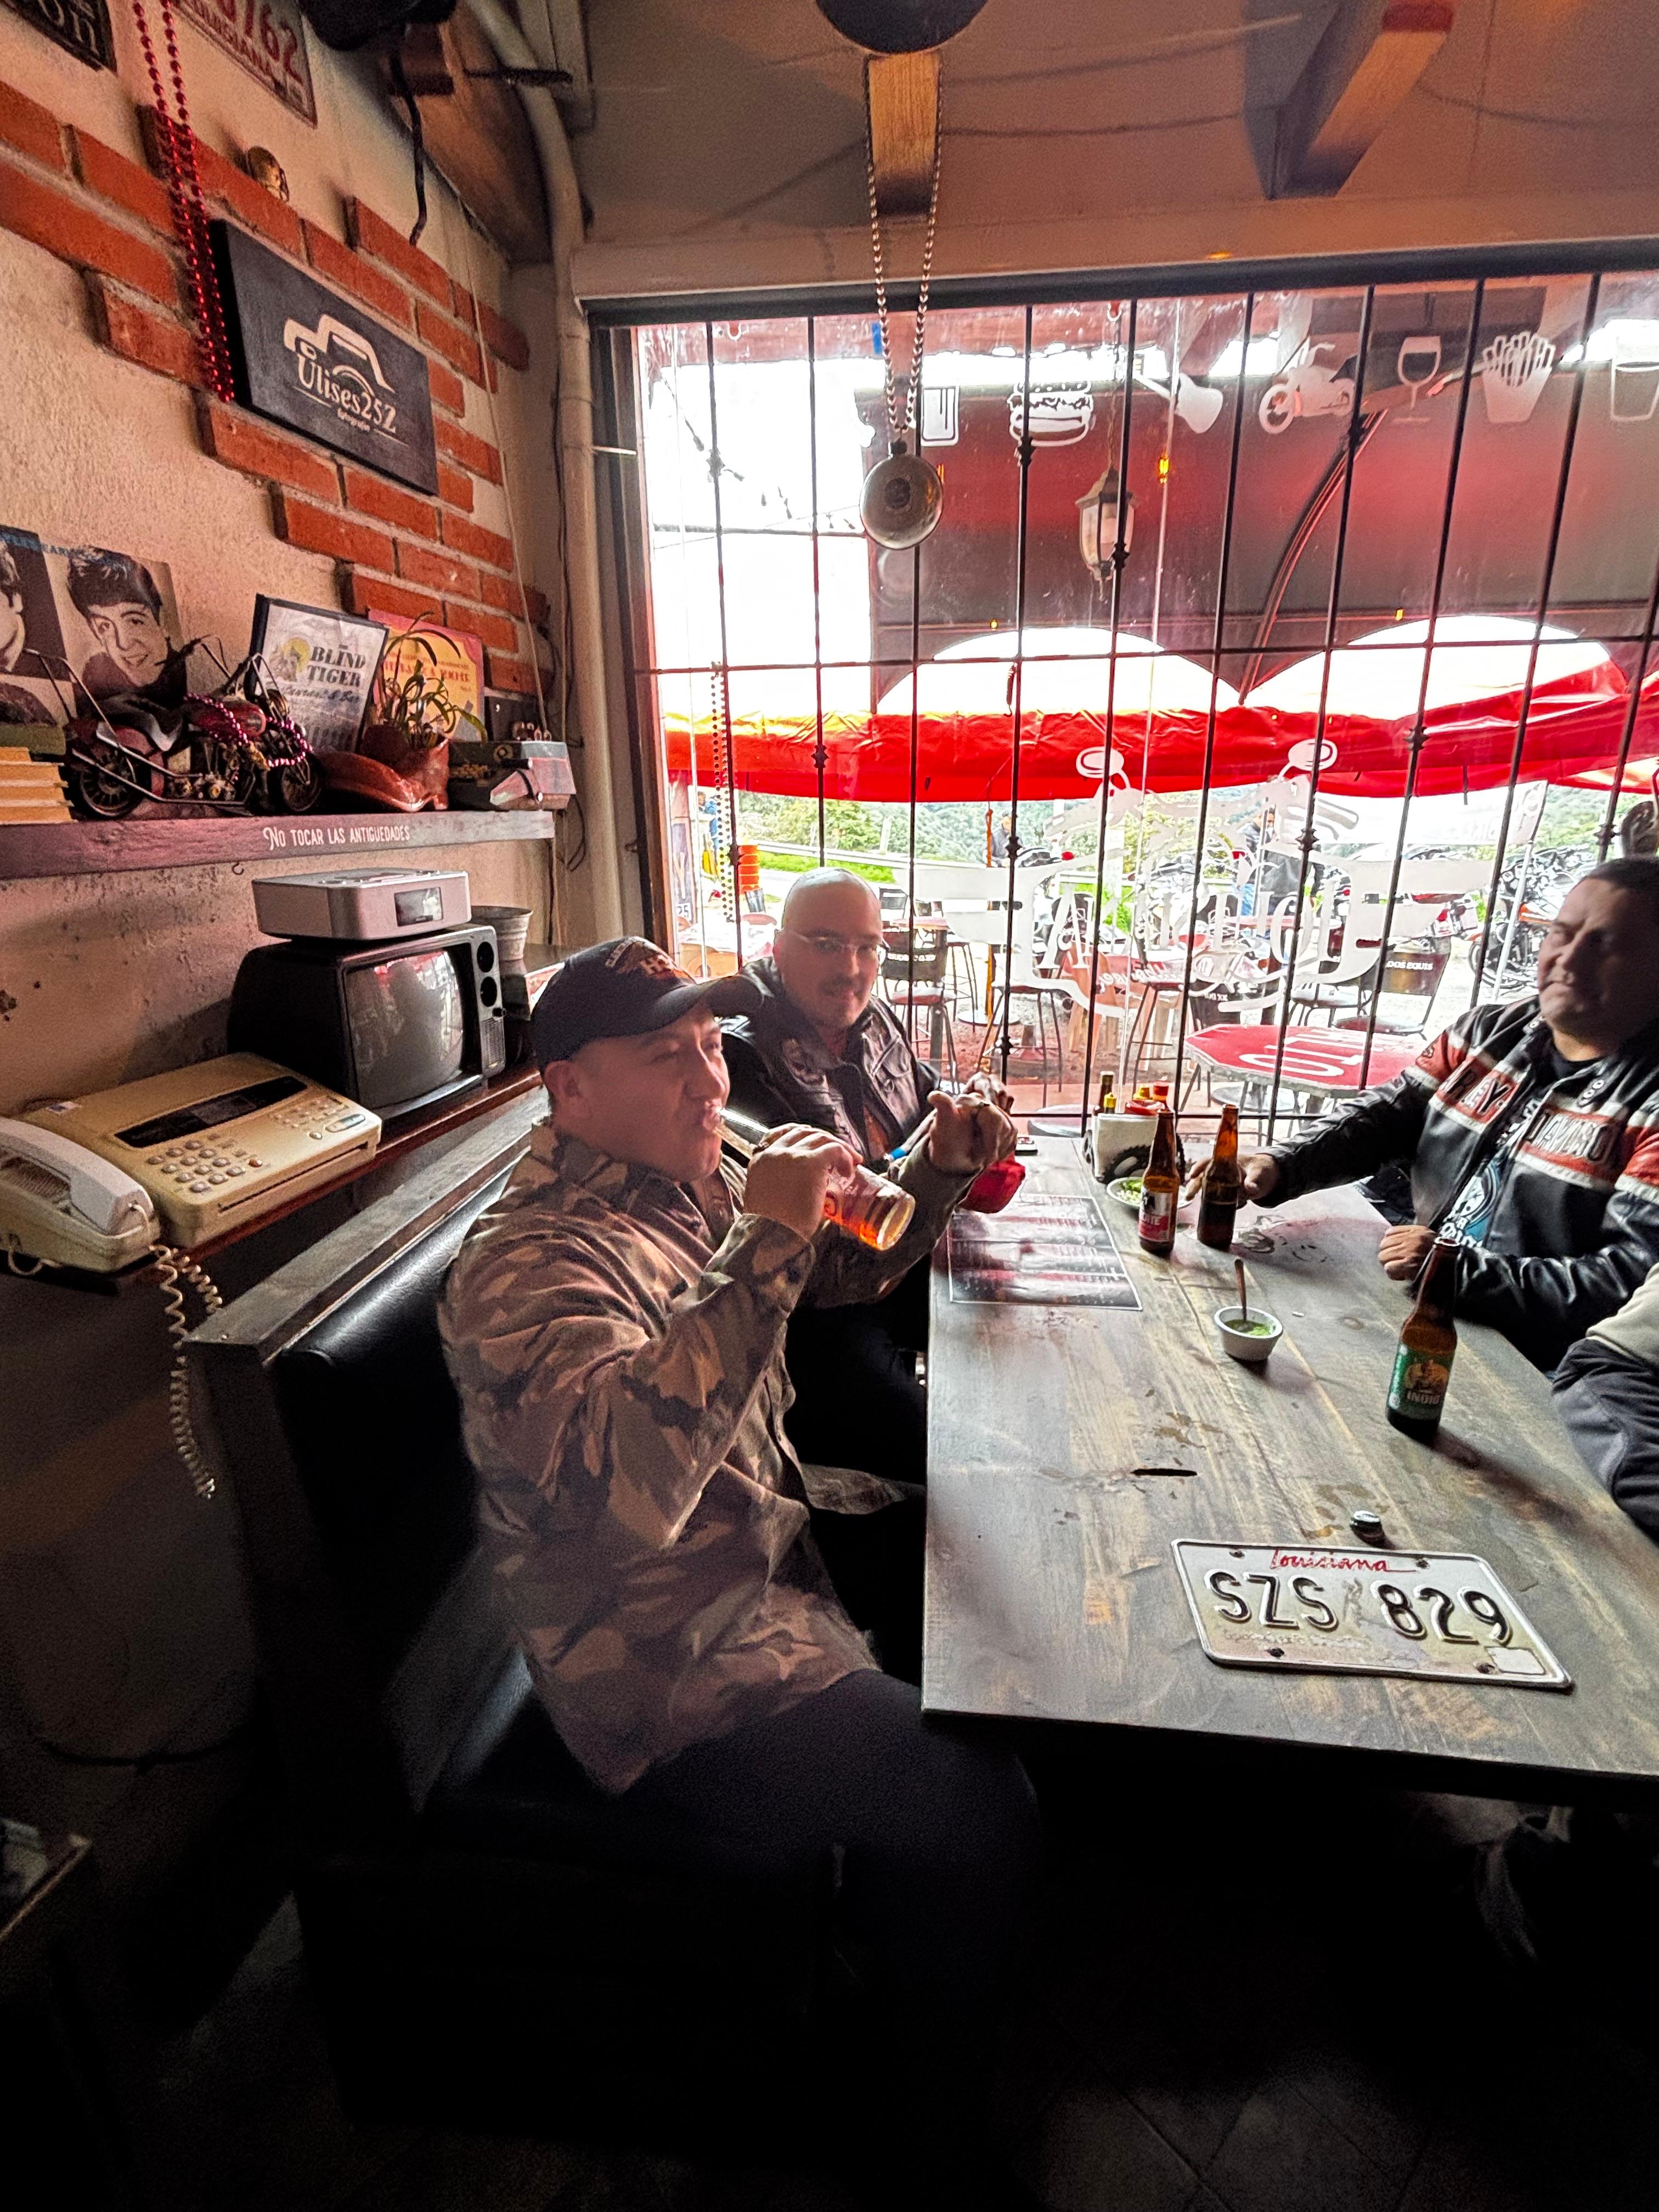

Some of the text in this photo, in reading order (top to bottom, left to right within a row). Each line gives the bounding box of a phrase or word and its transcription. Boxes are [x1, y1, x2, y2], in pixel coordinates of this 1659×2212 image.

[311, 646, 366, 669] BLIND
[307, 665, 361, 687] TIGER
[290, 828, 325, 847] TOCAR
[328, 827, 346, 845] LAS
[350, 825, 411, 843] ANTIGUEDADES
[1407, 1390, 1441, 1406] INDIO
[1269, 1548, 1417, 1573] Louisiana
[1204, 1570, 1513, 1646] SZS 829
